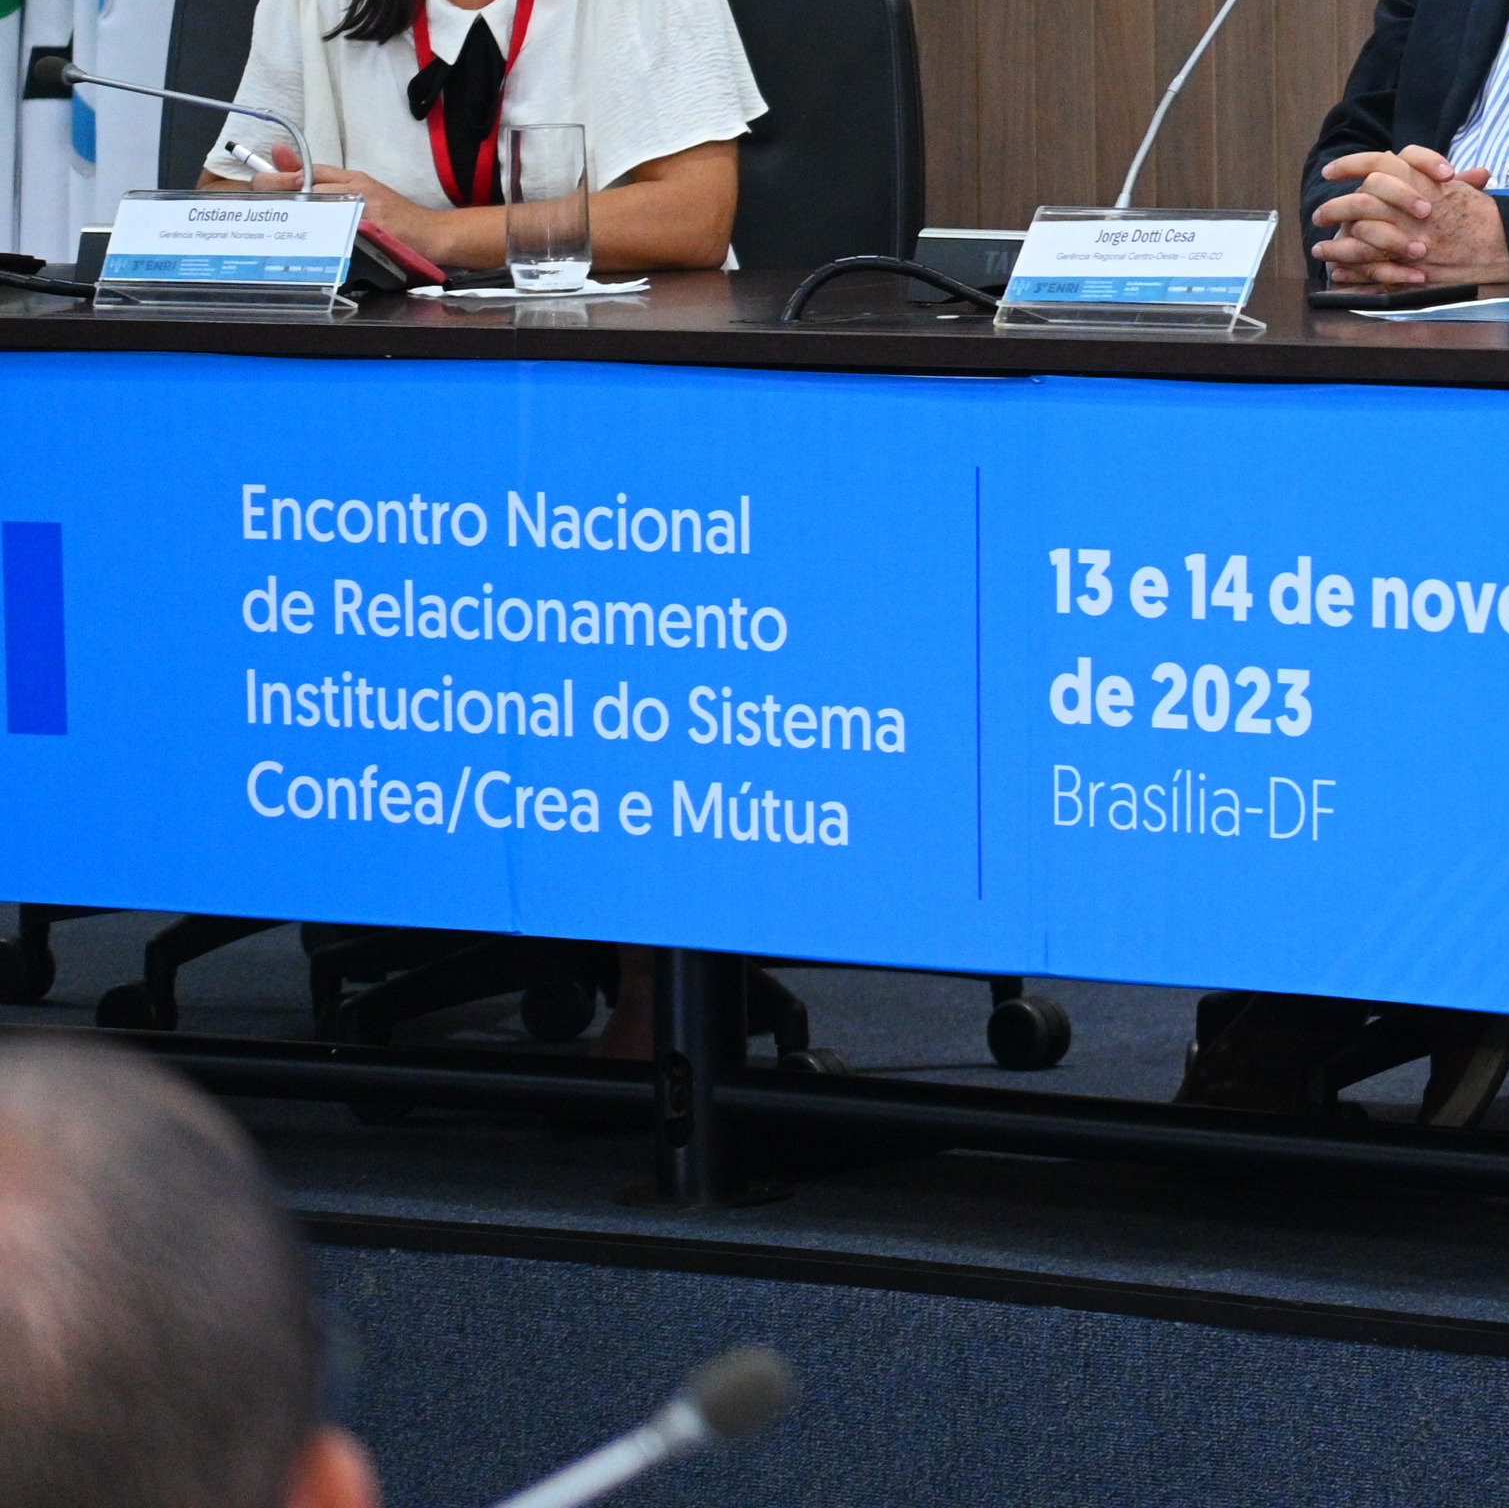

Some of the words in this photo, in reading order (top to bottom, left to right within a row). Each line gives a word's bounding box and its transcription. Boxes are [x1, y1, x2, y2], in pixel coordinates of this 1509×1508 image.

[159, 230, 193, 239] Gerência
[195, 230, 228, 241] Regional
[230, 231, 265, 240] Nordeste
[188, 207, 242, 222] Cristiane
[244, 208, 289, 223] Justino
[1095, 228, 1129, 246] Jorge
[1131, 228, 1163, 243] Dotti
[1165, 228, 1196, 243] Cesa
[241, 484, 488, 547] Encontro
[507, 490, 752, 555] Nacional
[242, 575, 315, 634] de
[334, 578, 788, 652] Relacionamento
[1048, 548, 1113, 616] 13
[1129, 561, 1169, 619] e
[1184, 553, 1253, 622] 14
[1268, 556, 1354, 628] de
[246, 669, 573, 737] Institucional
[593, 681, 670, 742] do
[687, 685, 907, 754] Sistema
[1048, 657, 1134, 727] de
[1150, 661, 1313, 737] 2023
[246, 760, 601, 834] Confea/Crea
[618, 787, 653, 833] e
[672, 780, 851, 847] Mútua
[1051, 764, 1337, 842] Brasília-DF
